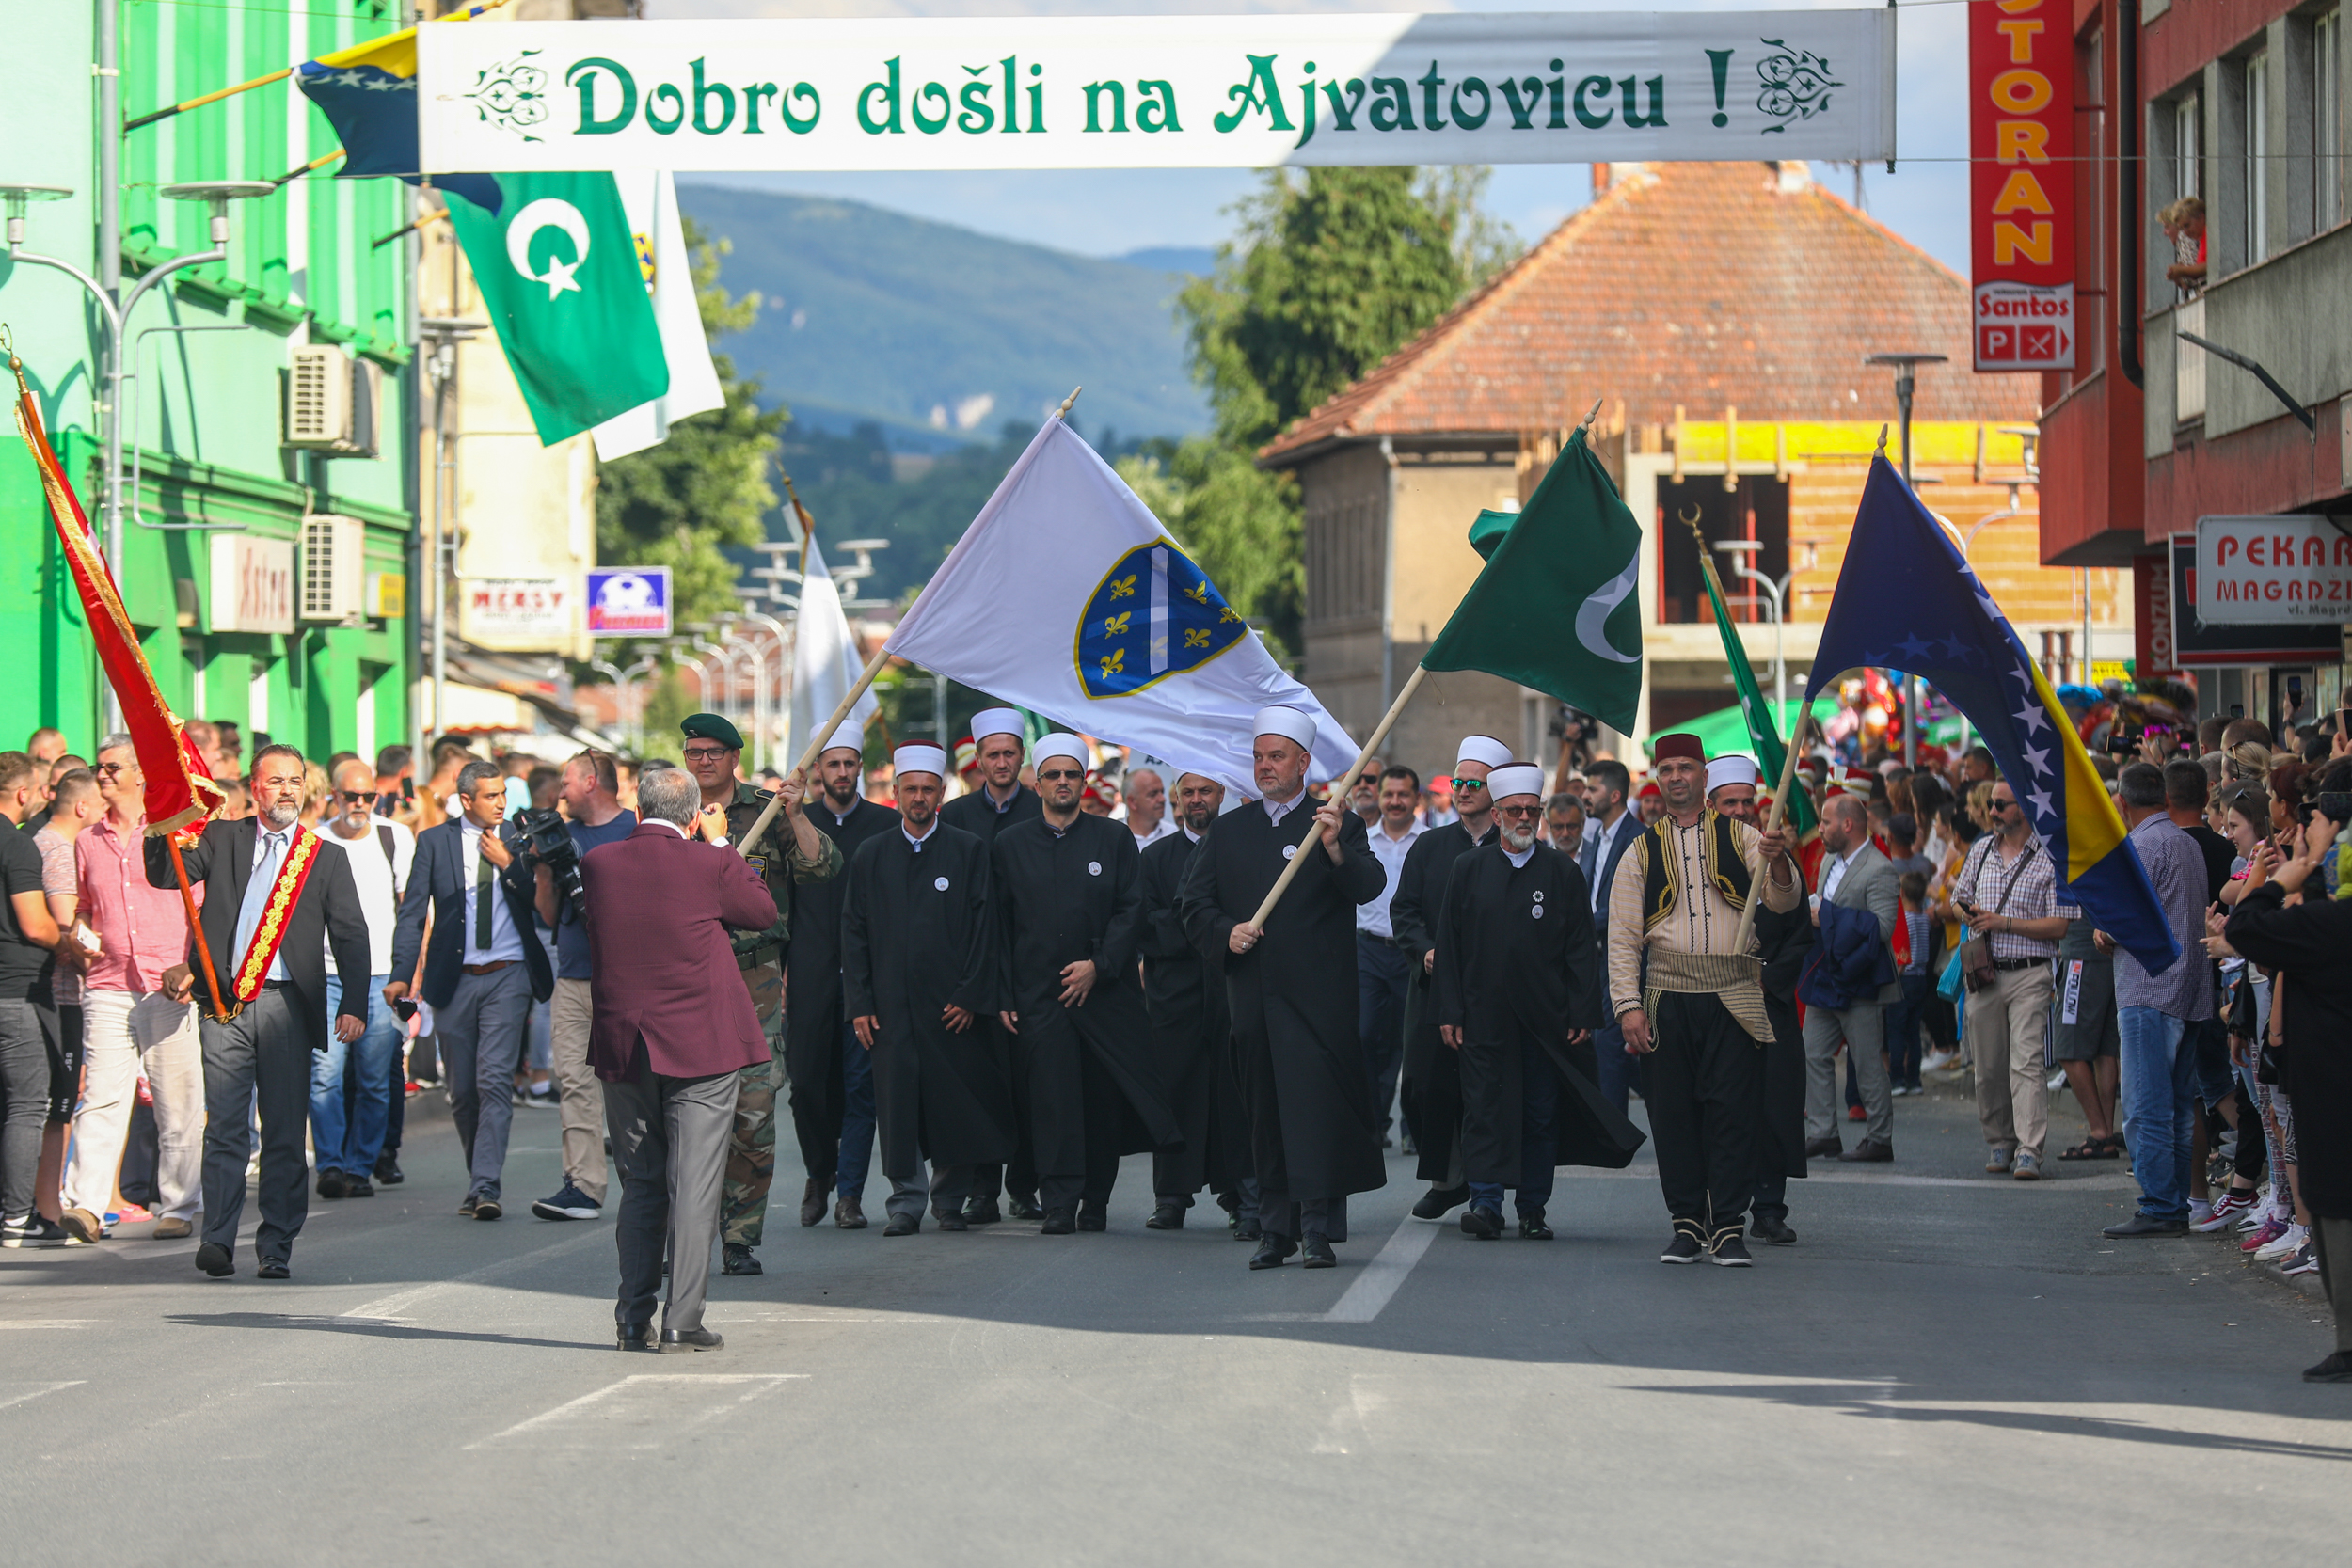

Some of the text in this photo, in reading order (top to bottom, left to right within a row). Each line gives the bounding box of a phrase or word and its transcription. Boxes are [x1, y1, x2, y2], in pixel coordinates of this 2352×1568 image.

[565, 49, 1733, 150] Dobro došli na Ajvatovicu !
[1979, 293, 2069, 318] Santos
[1988, 330, 2008, 356] P
[2217, 535, 2352, 567] PEKAR
[2151, 563, 2170, 672] KONZUM
[2288, 605, 2304, 615] vl.
